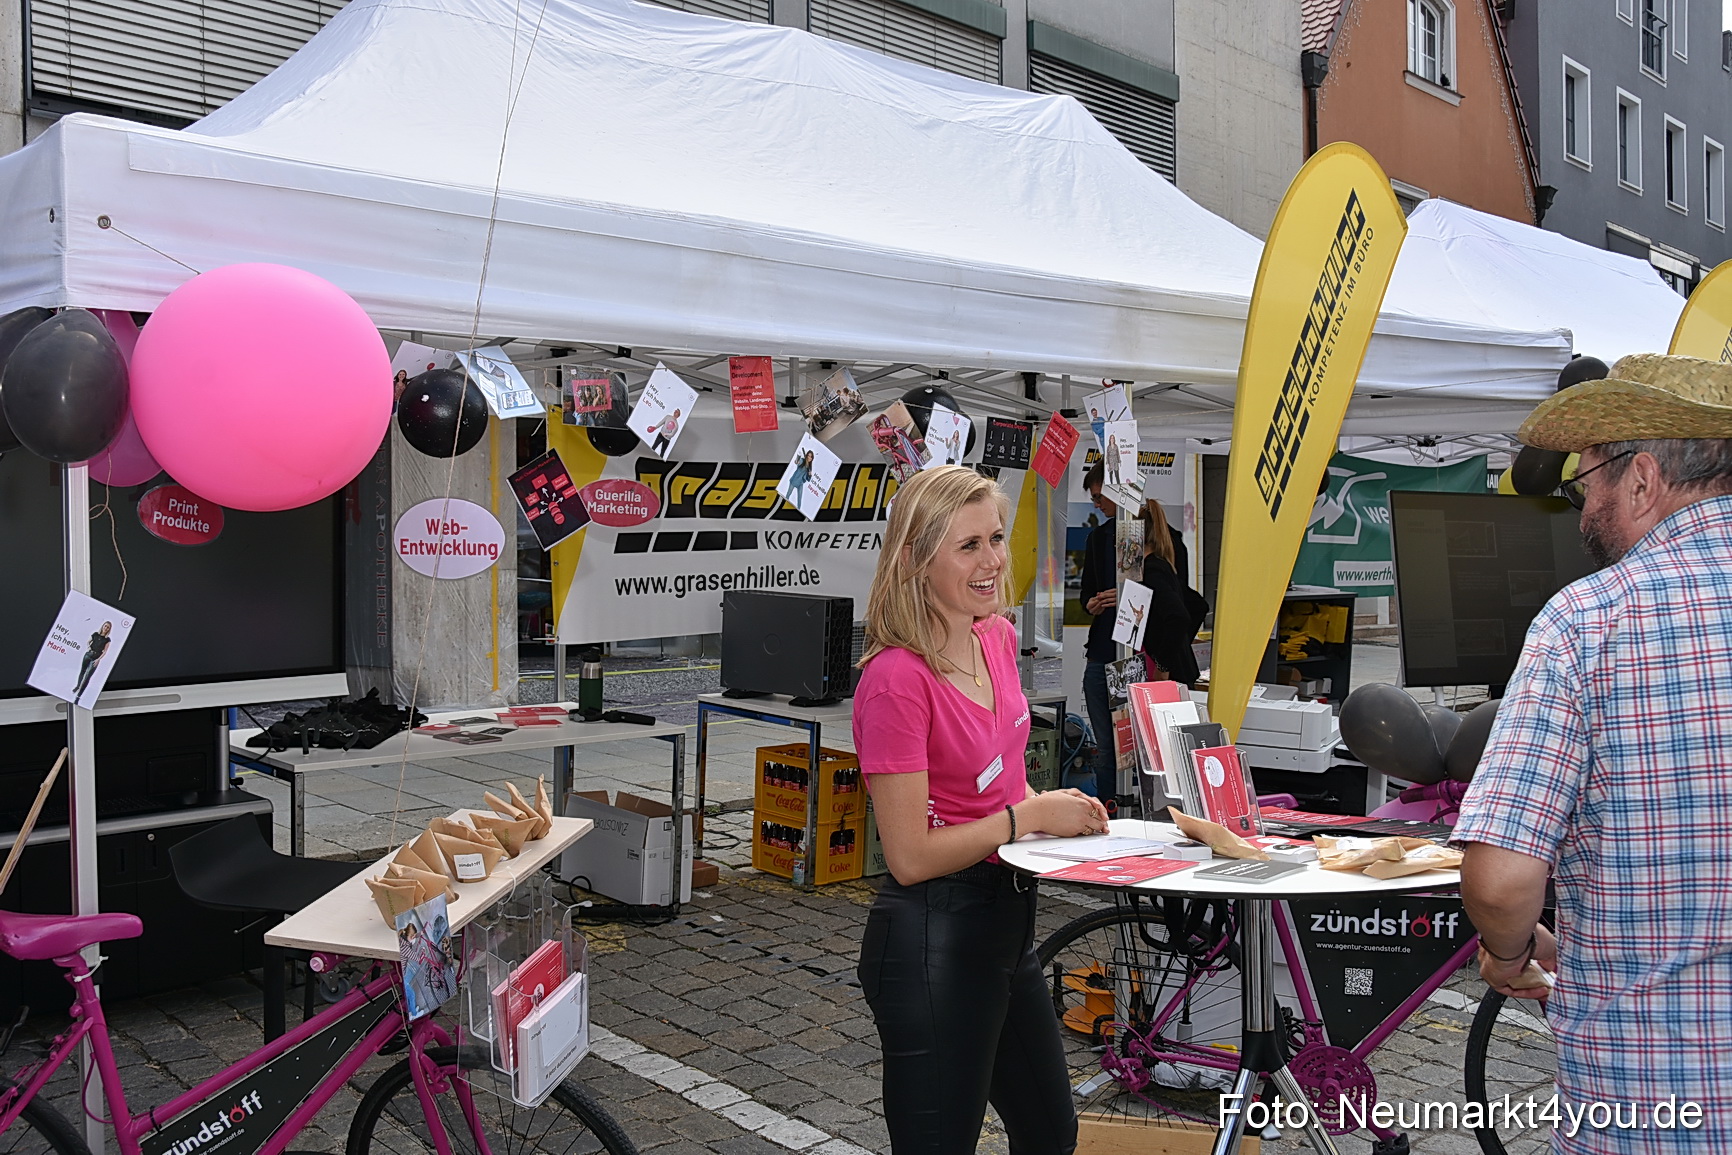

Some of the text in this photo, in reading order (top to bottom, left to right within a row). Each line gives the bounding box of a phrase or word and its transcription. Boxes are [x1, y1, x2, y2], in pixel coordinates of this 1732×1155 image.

[1307, 227, 1374, 407] KOMPETENZ IM BÜRO
[1254, 188, 1366, 506] grasenhiller
[1086, 449, 1174, 466] grhiller
[595, 488, 642, 503] Guerilla
[168, 498, 199, 516] Print
[587, 502, 648, 518] Marketing
[152, 510, 210, 534] Produkte
[425, 518, 468, 536] Web-
[400, 538, 498, 560] Entwicklung
[764, 530, 884, 551] KOMPETEN
[614, 563, 821, 598] www.grasenhiller.de
[56, 624, 70, 636] Hey,
[46, 640, 67, 655] Marie.
[51, 632, 81, 651] ich heiße
[832, 802, 854, 813] Coke
[830, 862, 852, 874] Coke
[1310, 908, 1459, 938] zündstoff
[1316, 942, 1411, 954] www.agentur-zuendstoff.de
